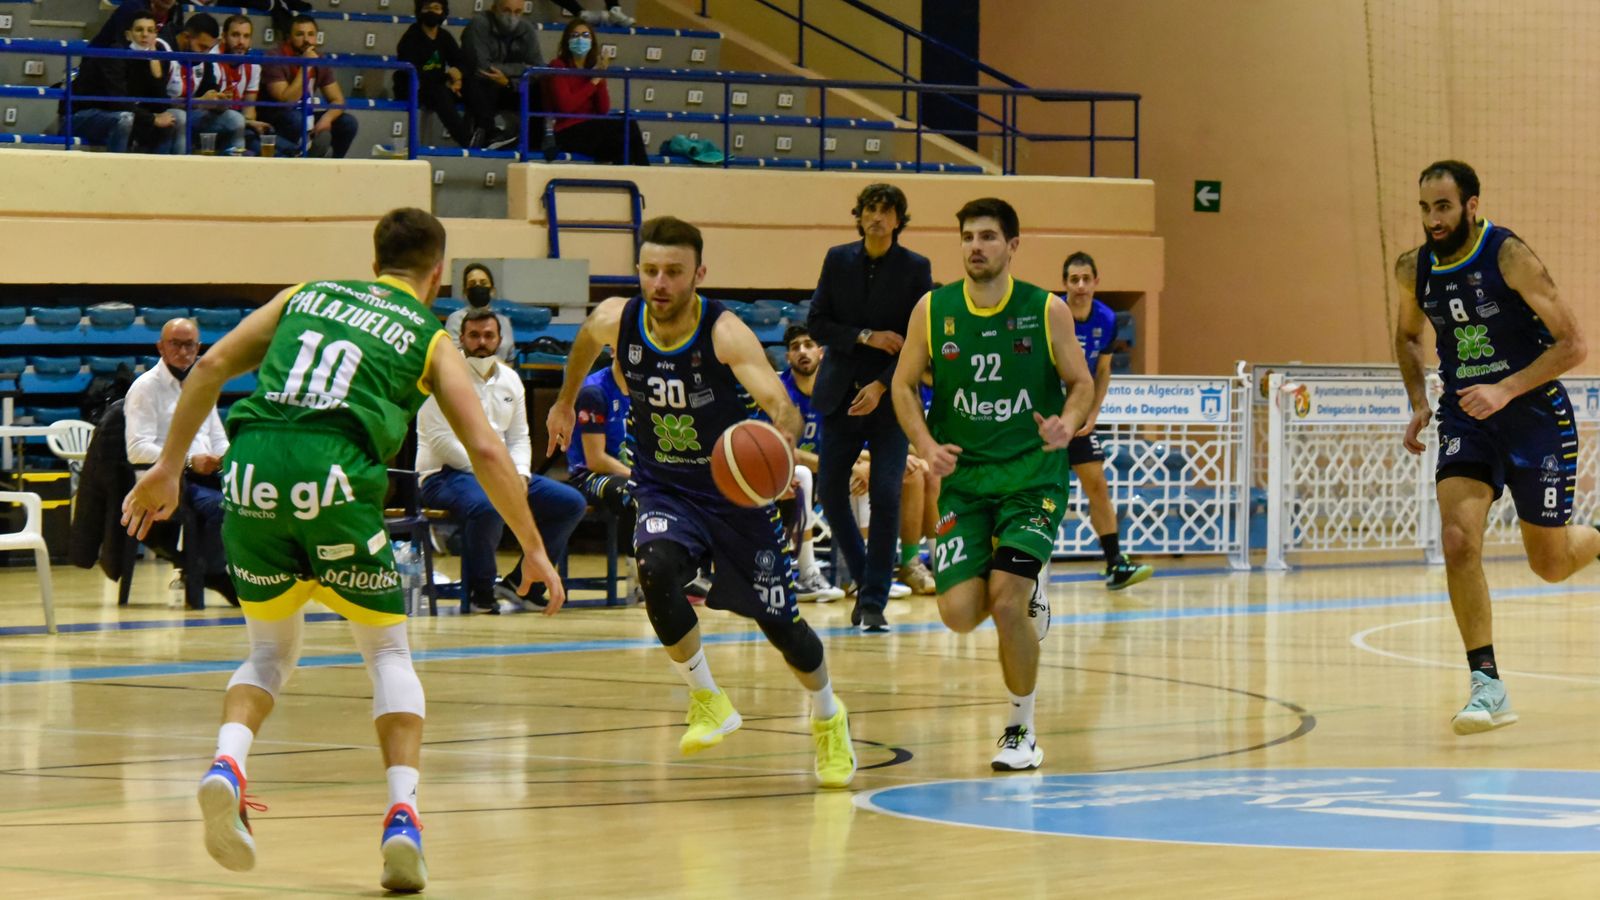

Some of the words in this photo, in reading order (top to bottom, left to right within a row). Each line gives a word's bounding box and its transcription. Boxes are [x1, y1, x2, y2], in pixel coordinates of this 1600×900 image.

[1449, 298, 1469, 322] 8
[286, 290, 416, 355] PALAZUELOS
[284, 329, 363, 399] 10
[971, 353, 1003, 382] 22
[1456, 359, 1510, 379] damex
[647, 377, 686, 408] 30
[1134, 386, 1145, 395] de
[1147, 385, 1194, 398] Algeciras
[1314, 385, 1363, 397] Ayuntamiento
[1374, 386, 1404, 398] Algeciras
[1125, 405, 1138, 414] de
[1141, 404, 1189, 416] Deportes
[1317, 404, 1356, 416] Delegación
[1369, 404, 1400, 416] Deportes
[1544, 487, 1557, 509] 8
[936, 536, 967, 573] 22
